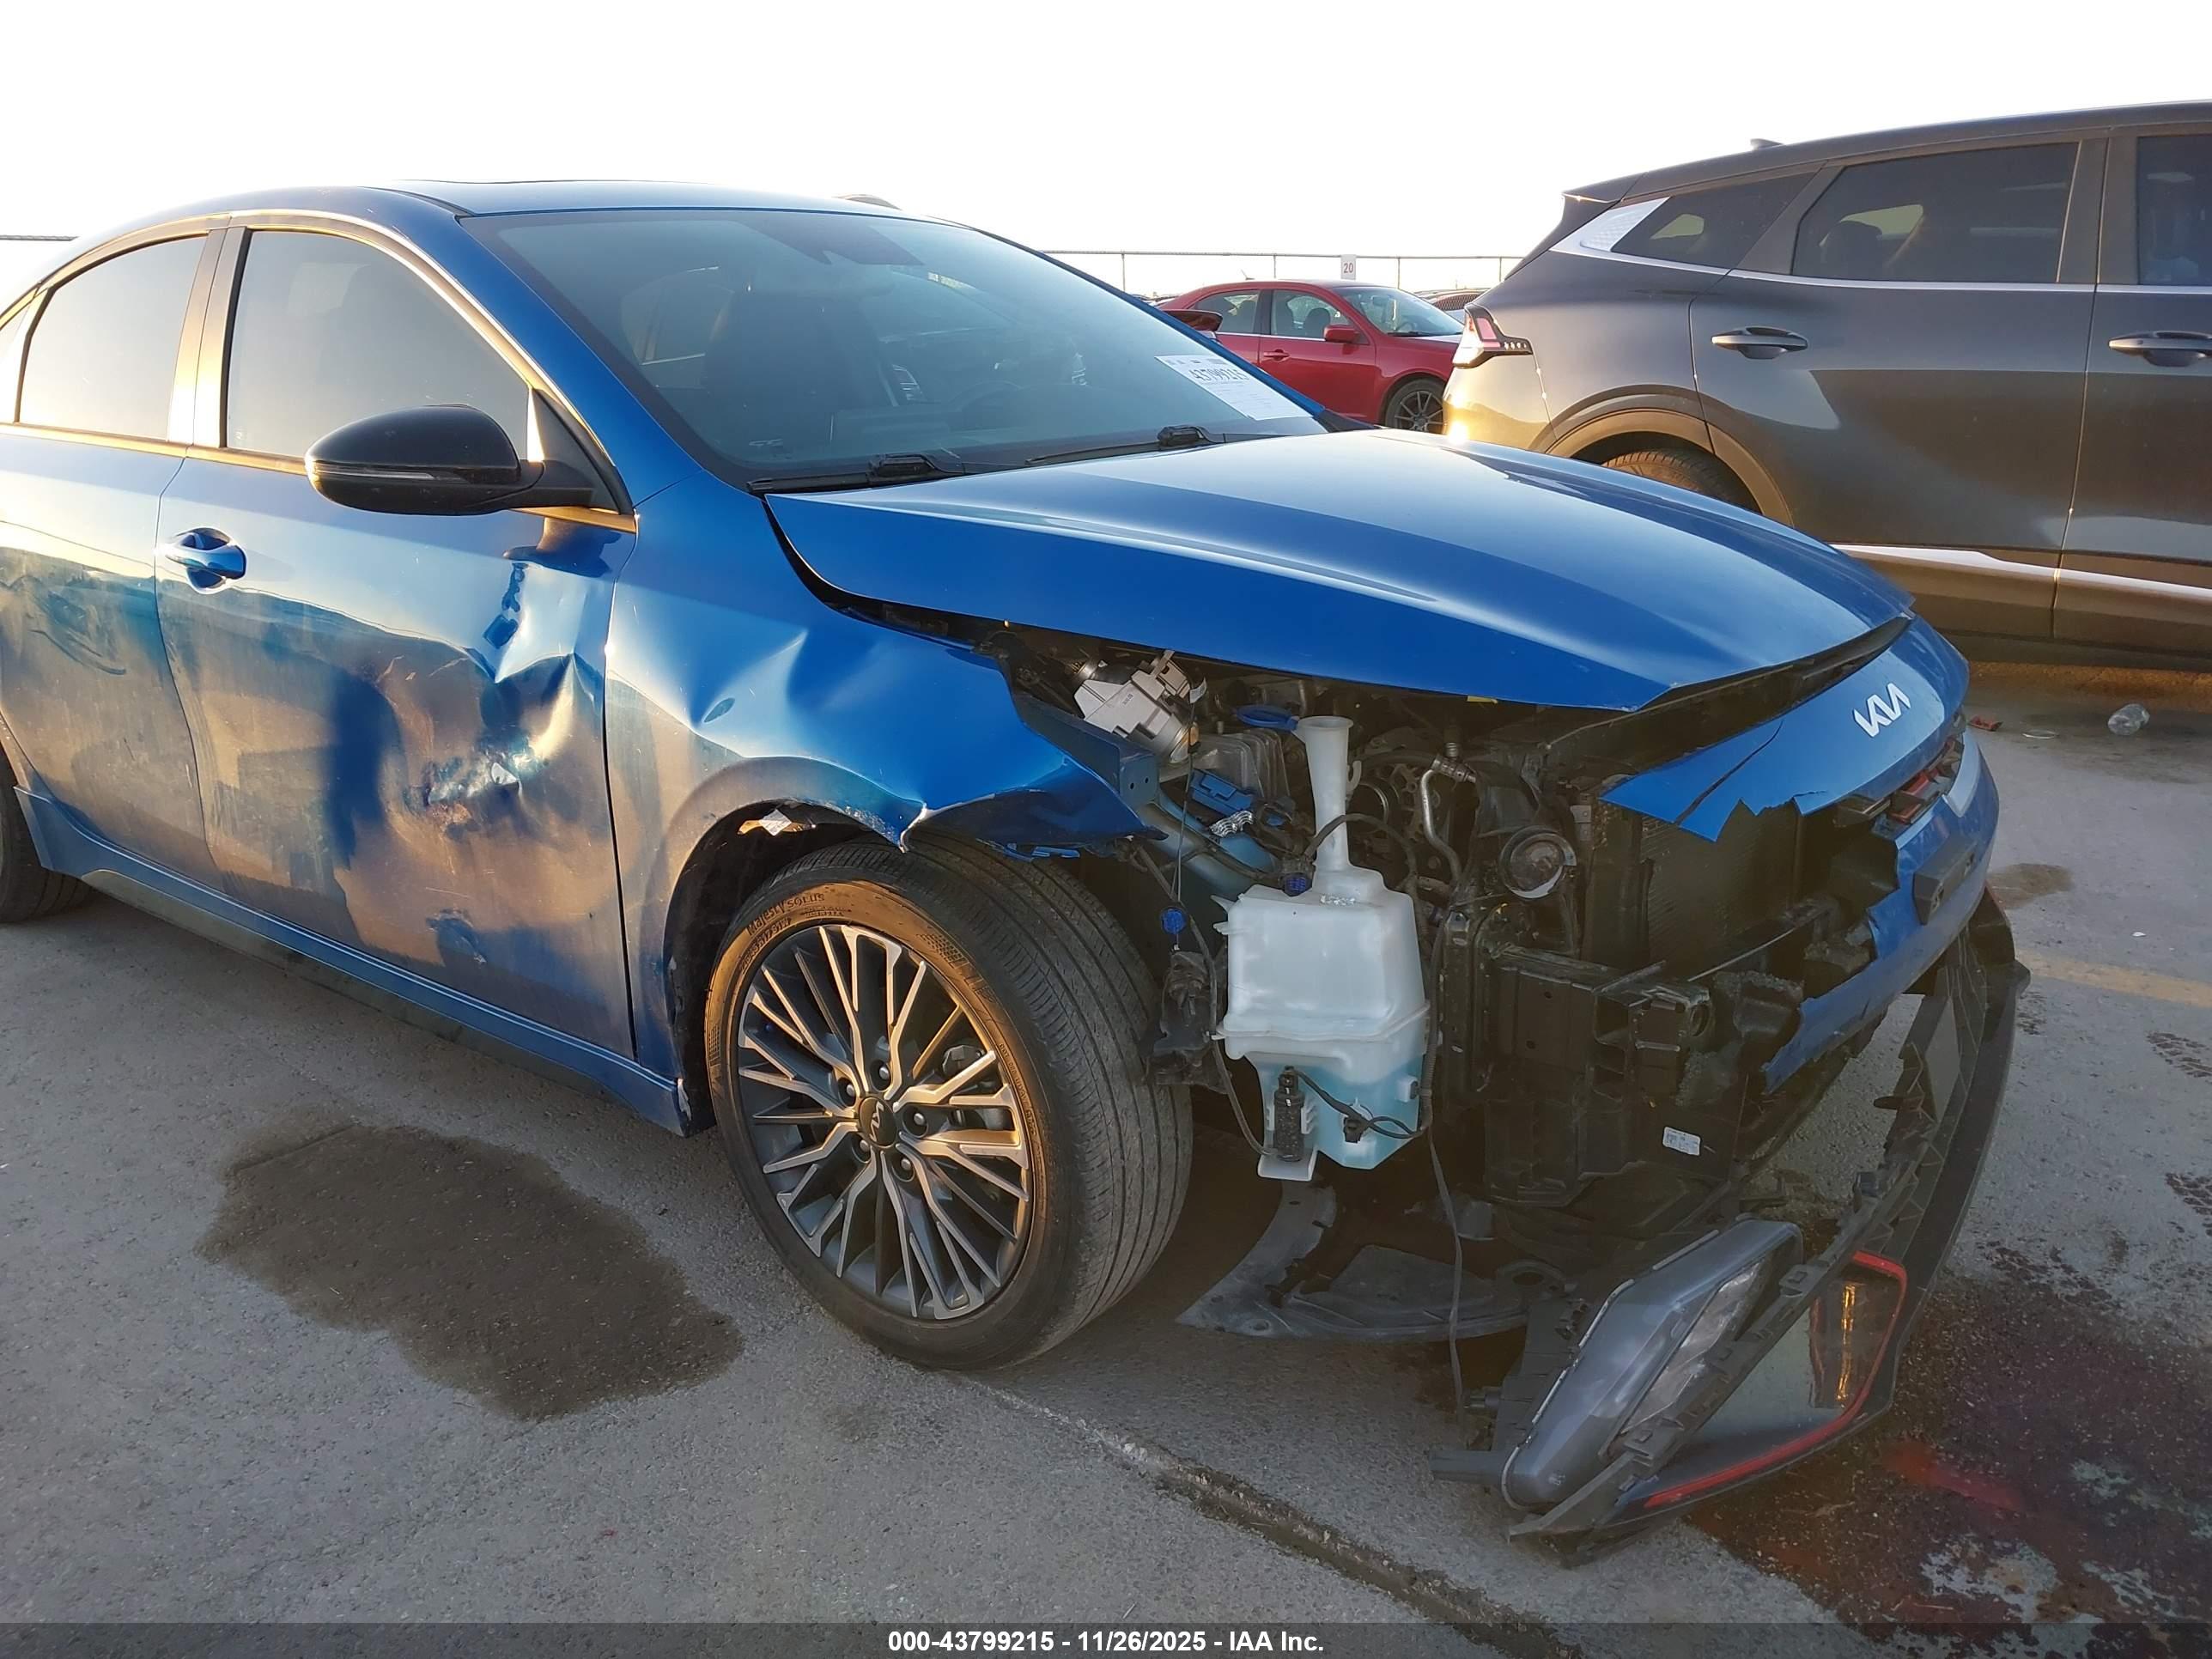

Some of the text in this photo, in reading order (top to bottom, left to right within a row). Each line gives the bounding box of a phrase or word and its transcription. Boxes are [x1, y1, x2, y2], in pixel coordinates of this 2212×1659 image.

[1344, 263, 1353, 273] 20
[1853, 683, 1911, 738] KIA
[787, 893, 825, 908] SOLUS
